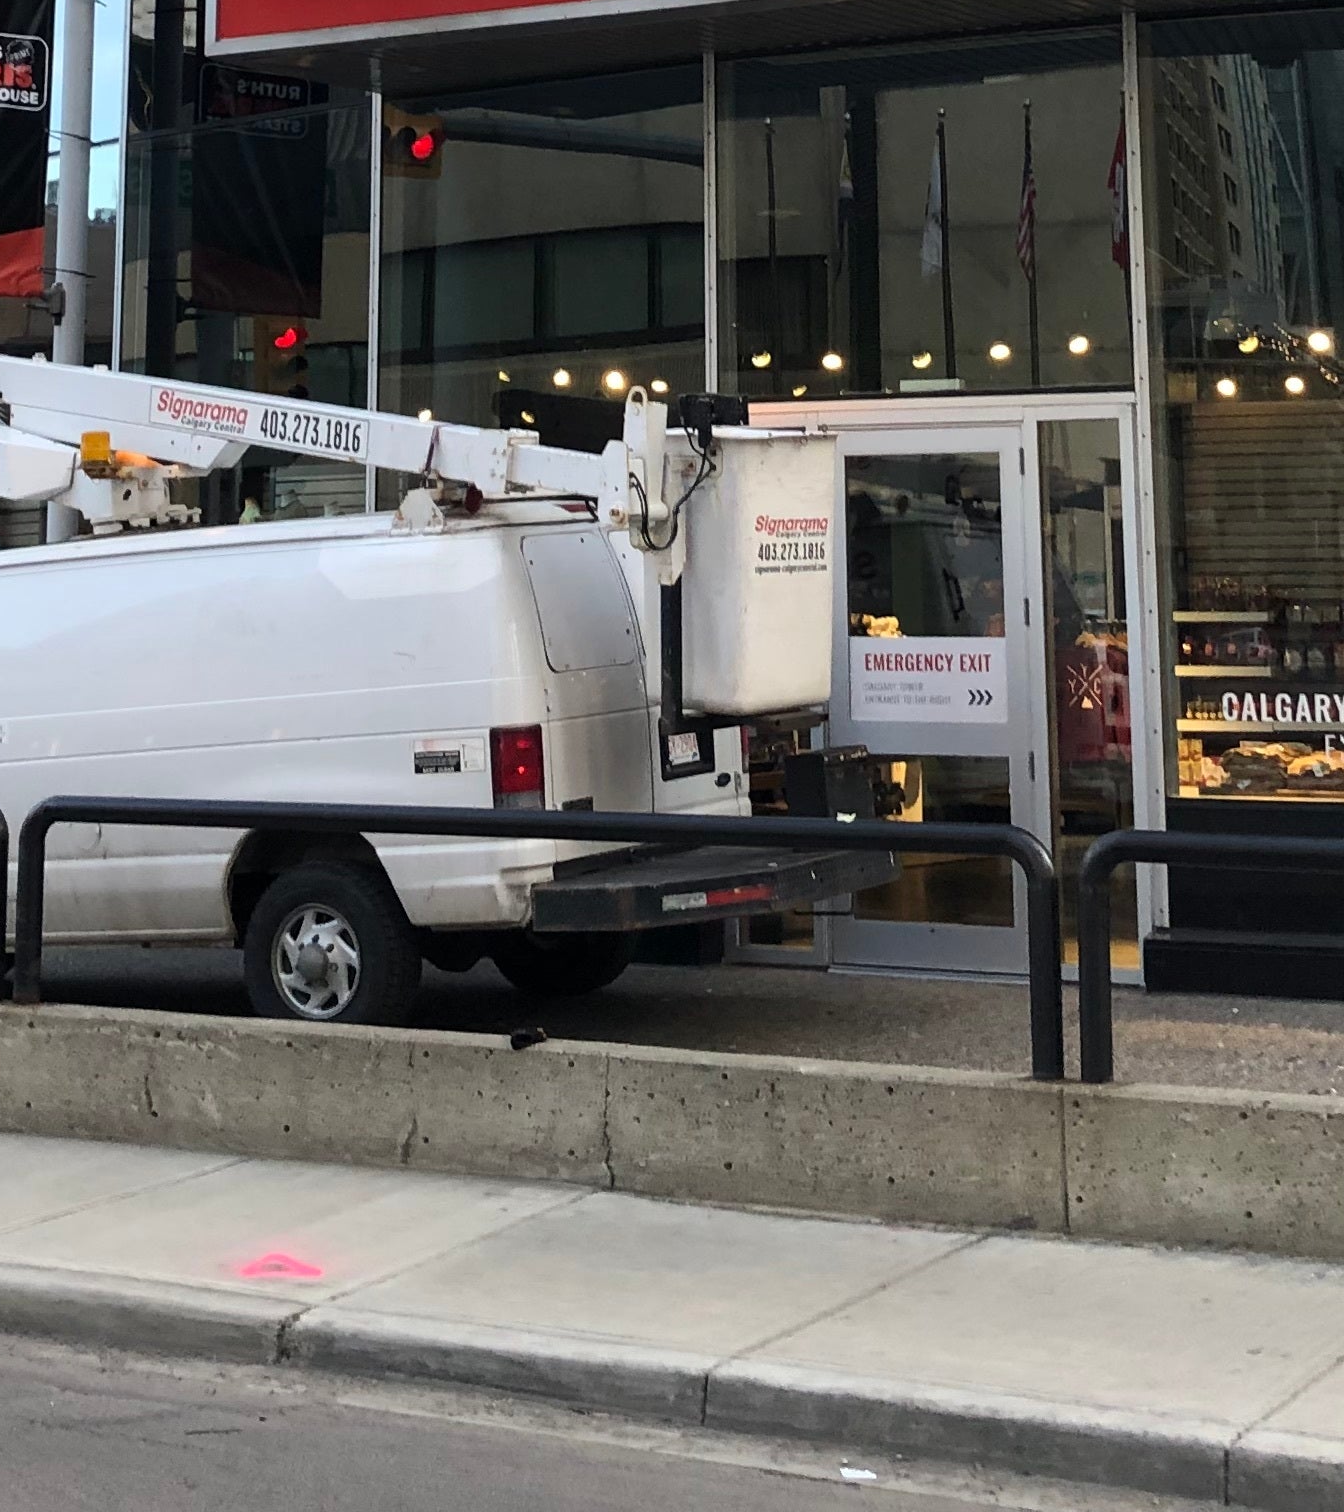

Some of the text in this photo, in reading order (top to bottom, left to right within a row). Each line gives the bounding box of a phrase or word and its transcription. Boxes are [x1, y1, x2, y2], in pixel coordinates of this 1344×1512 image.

[157, 390, 249, 426] Signarama
[181, 415, 245, 435] Calgary Central
[260, 407, 361, 453] 403.273.1816
[755, 515, 828, 536] Signarama
[758, 542, 825, 561] 403.273.1816
[864, 653, 992, 673] EMERGENCY EXIT
